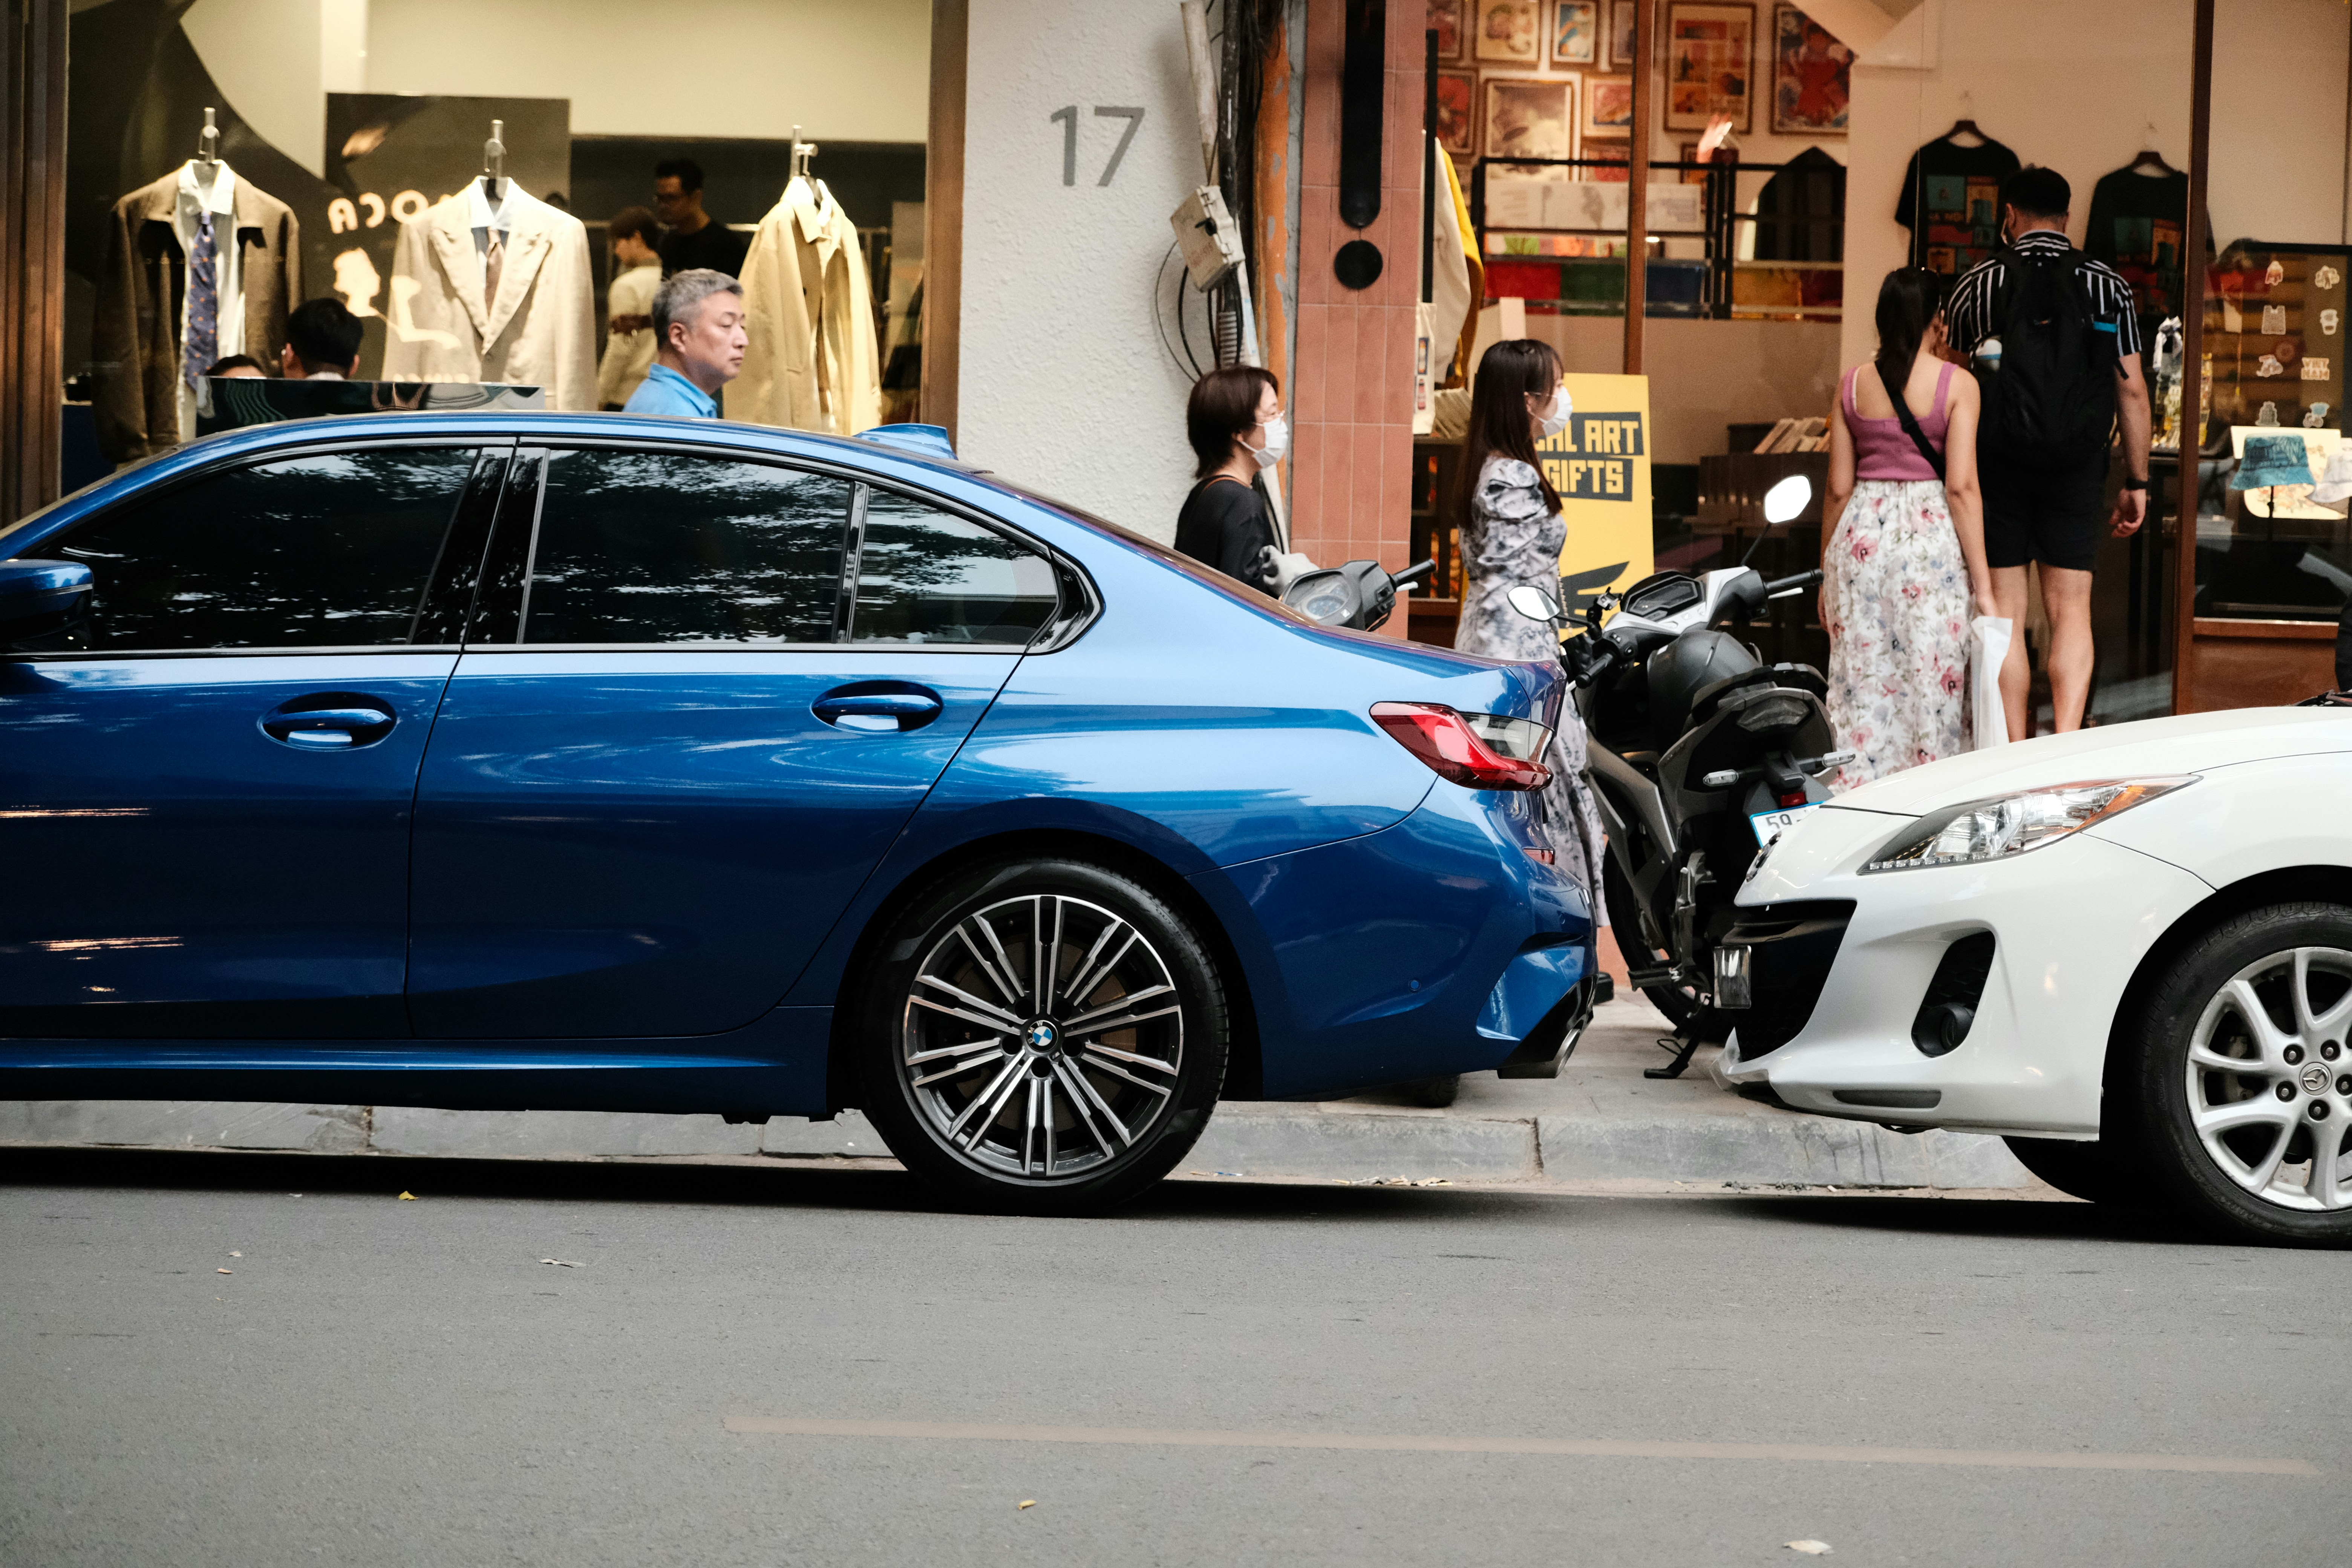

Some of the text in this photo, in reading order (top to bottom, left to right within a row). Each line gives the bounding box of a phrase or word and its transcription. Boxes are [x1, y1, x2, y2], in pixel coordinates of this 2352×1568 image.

[1050, 104, 1145, 187] 17
[1584, 420, 1639, 455] ART
[1542, 459, 1624, 494] GIFTS
[1027, 1021, 1043, 1044] BMW
